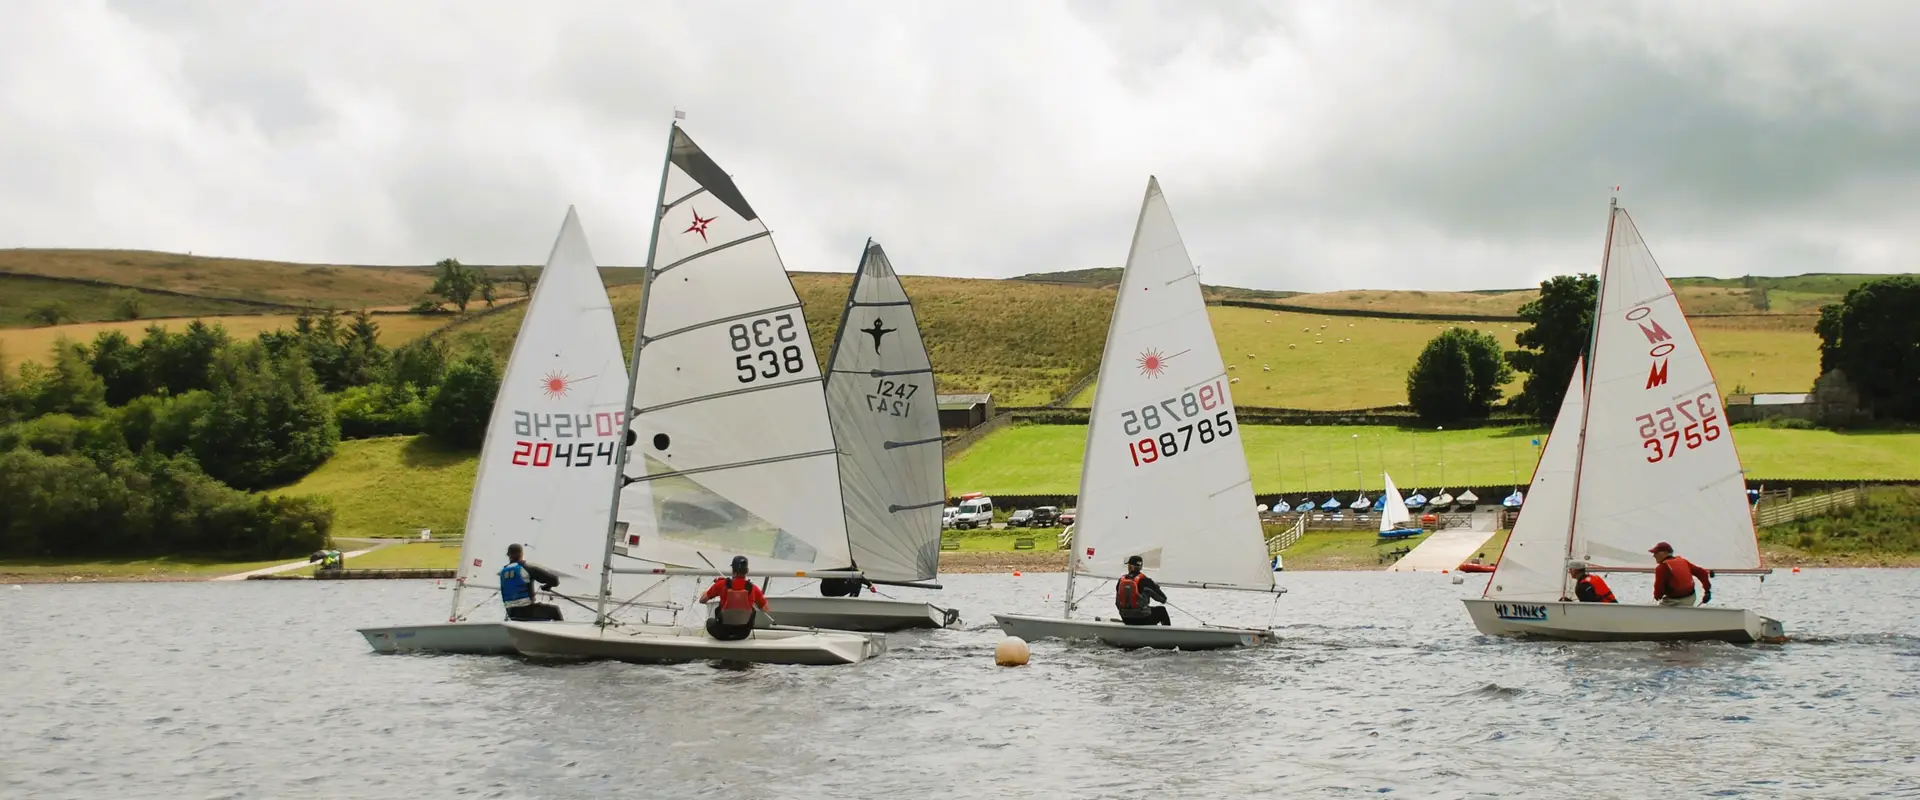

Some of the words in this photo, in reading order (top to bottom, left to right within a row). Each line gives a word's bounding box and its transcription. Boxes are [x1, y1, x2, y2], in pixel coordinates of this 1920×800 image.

[737, 345, 803, 383] 538
[877, 380, 918, 399] 1247
[1129, 411, 1232, 467] 198785
[1644, 415, 1720, 463] 3755
[1512, 604, 1548, 618] JINKS
